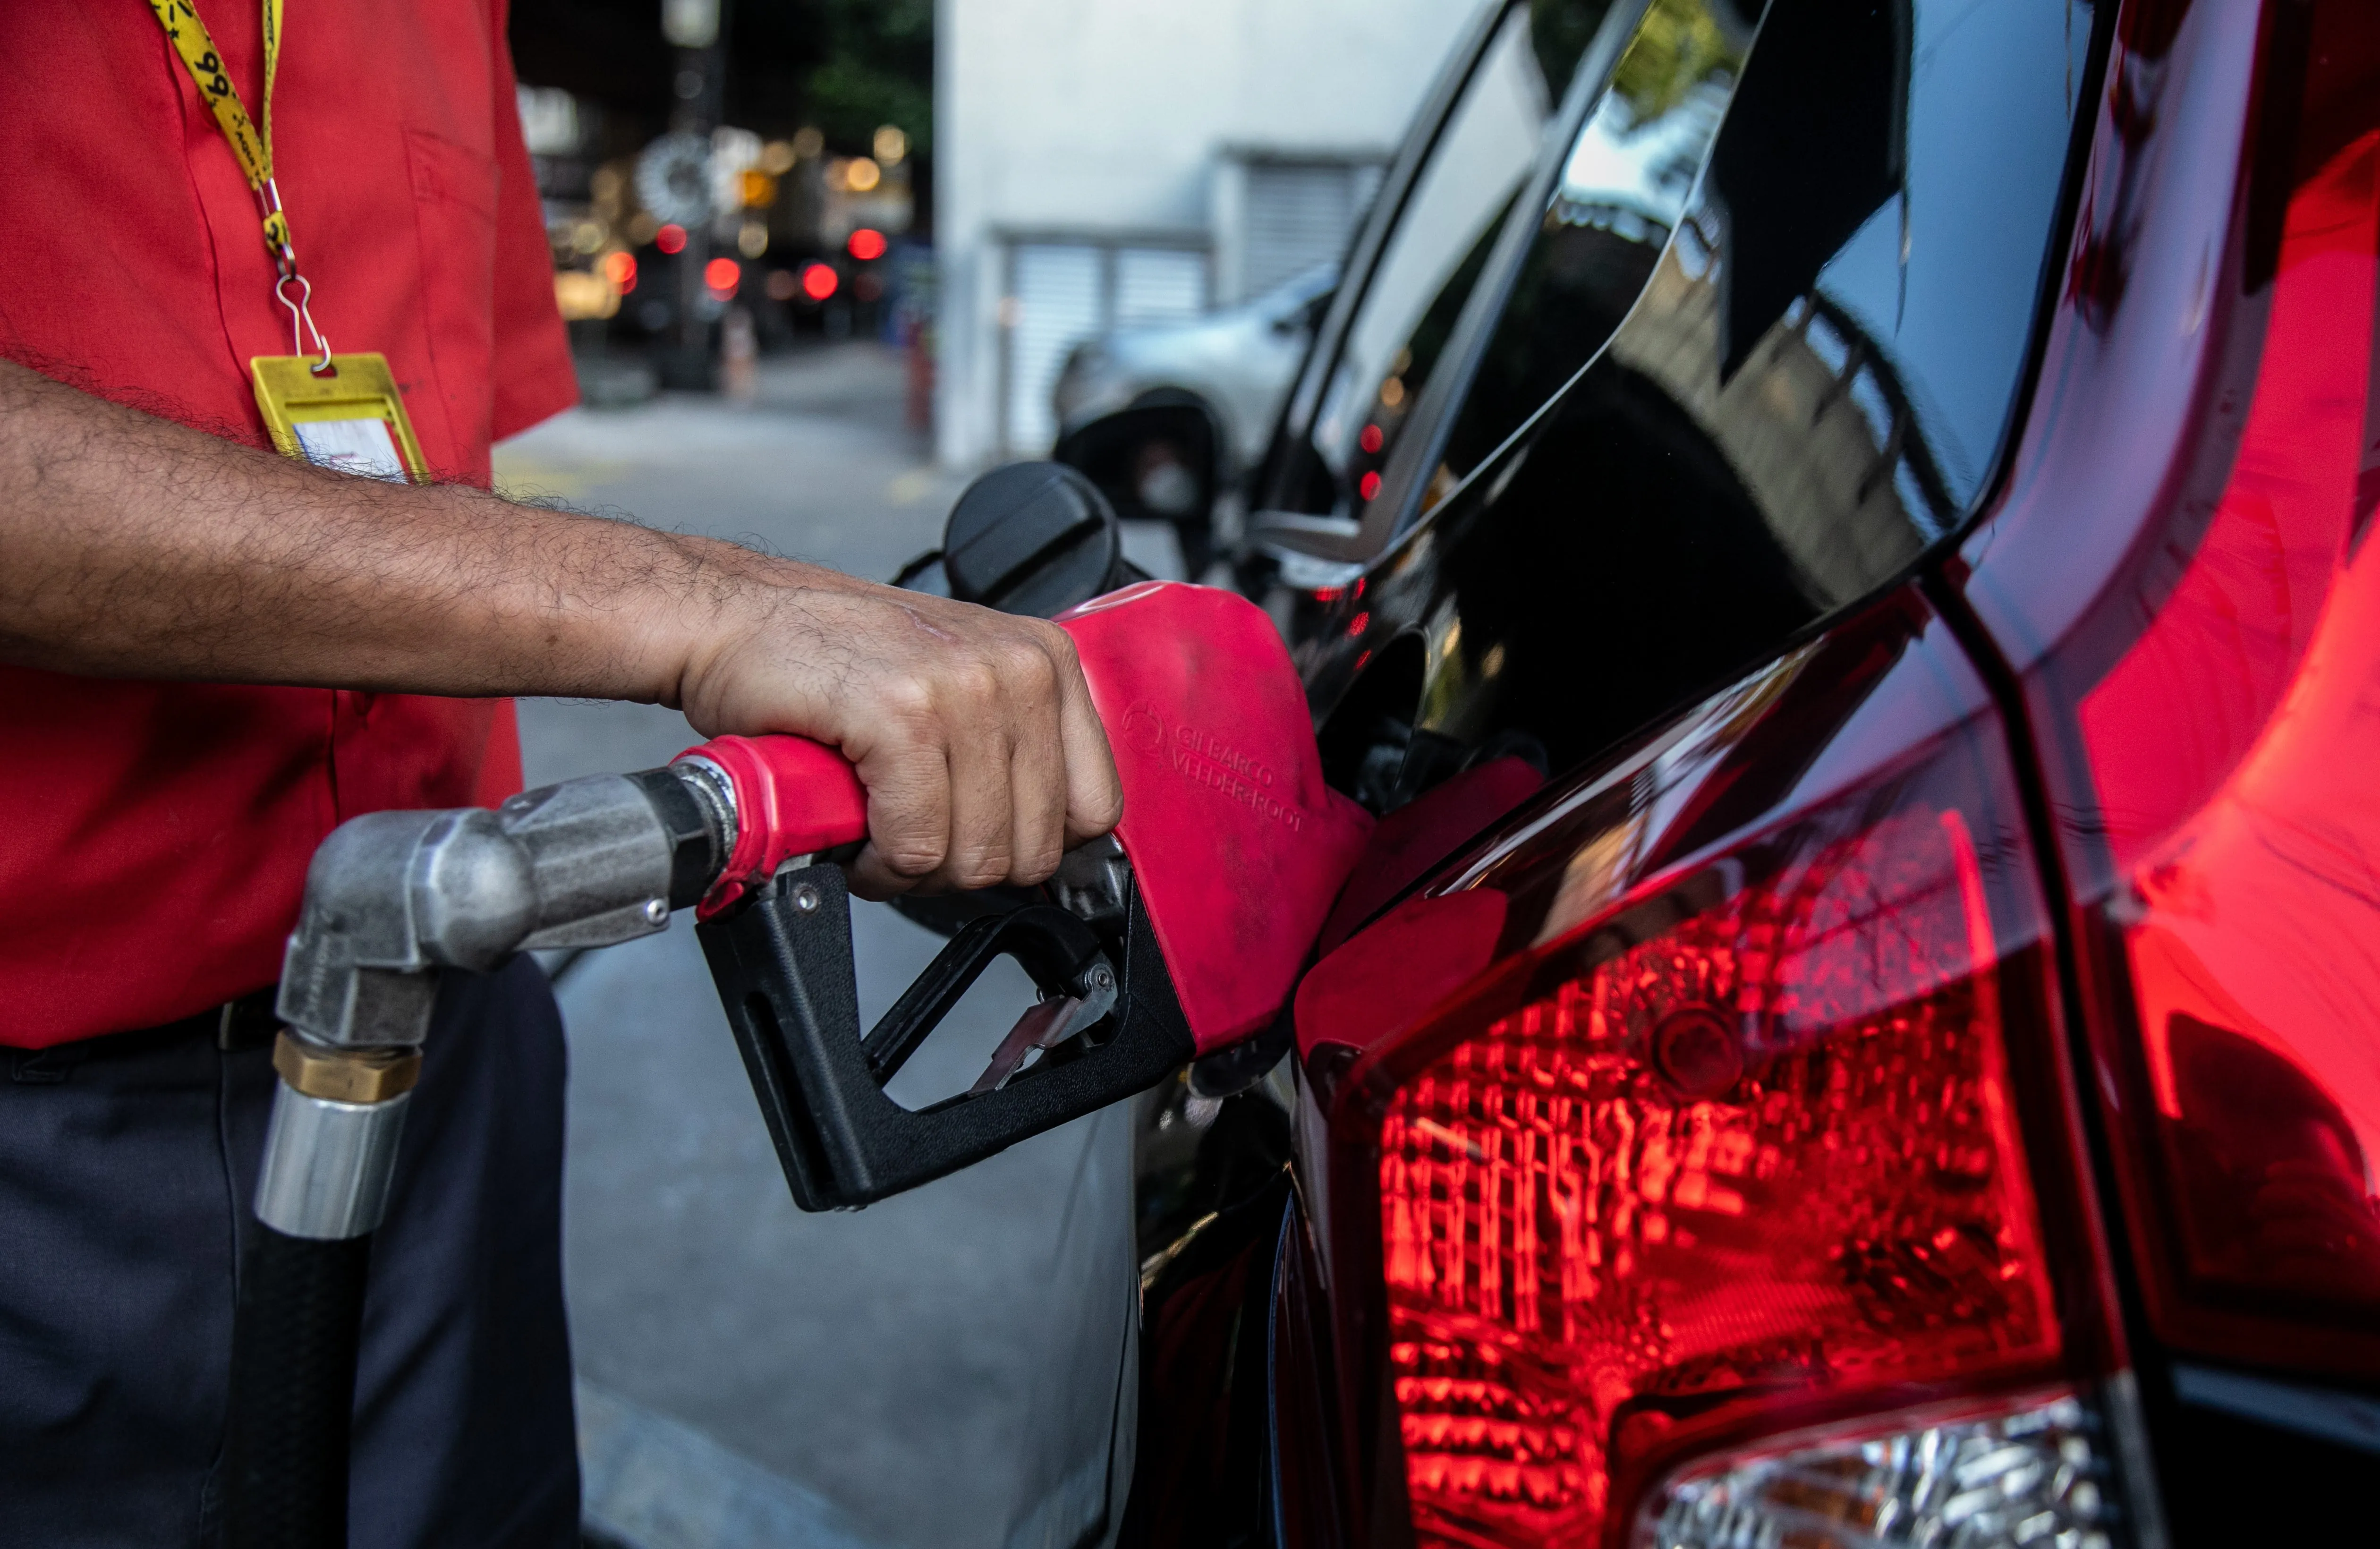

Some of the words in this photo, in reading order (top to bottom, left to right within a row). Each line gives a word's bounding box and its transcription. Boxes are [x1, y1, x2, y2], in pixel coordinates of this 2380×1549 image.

[194, 51, 229, 97] 99
[1176, 725, 1273, 788] GILBARCO
[1173, 747, 1304, 833] VEEDER-ROOT
